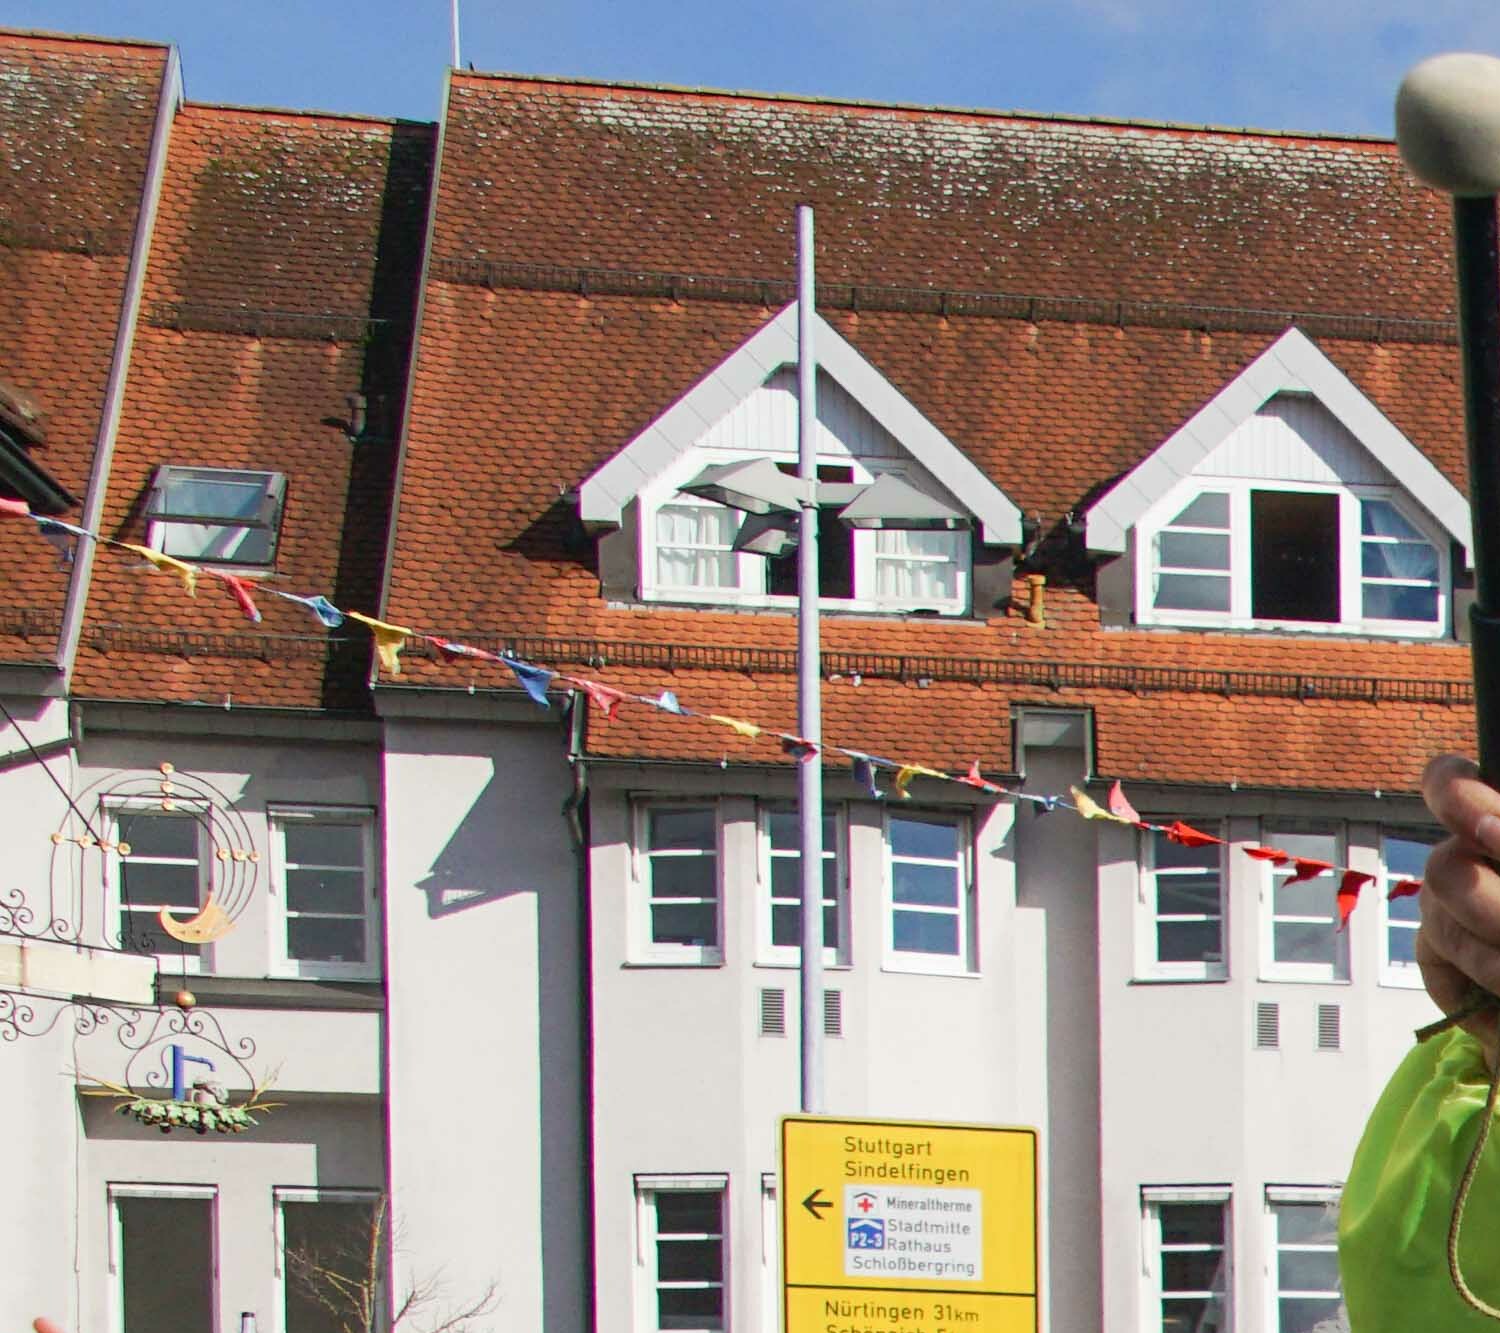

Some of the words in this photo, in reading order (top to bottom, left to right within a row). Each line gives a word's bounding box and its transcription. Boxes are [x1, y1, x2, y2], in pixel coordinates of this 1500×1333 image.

[844, 1136, 933, 1159] Stuttgart
[844, 1160, 970, 1184] Sindelfingen
[886, 1196, 973, 1213] Mineraltherme
[887, 1218, 972, 1235] Stadtmitte
[886, 1238, 952, 1253] Rathaus
[852, 1255, 976, 1277] Schloßbergring
[824, 1300, 925, 1323] Nürtingen
